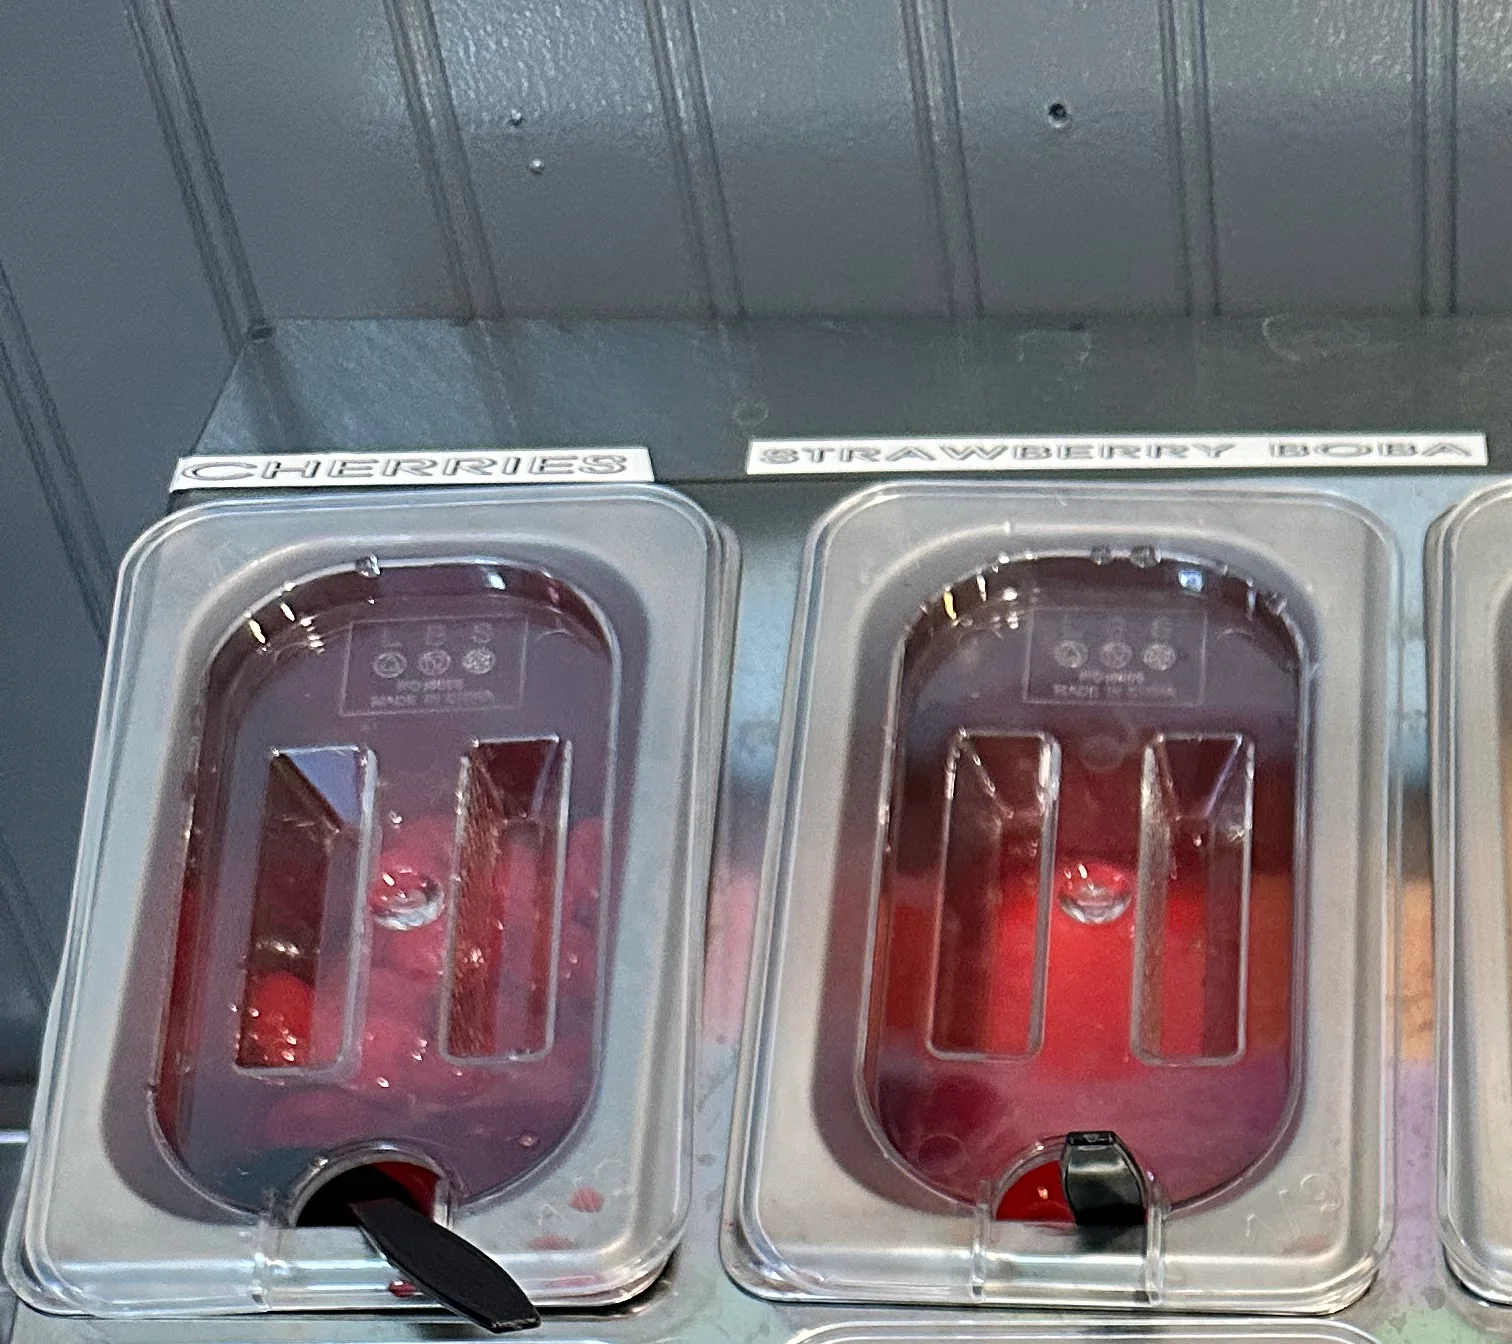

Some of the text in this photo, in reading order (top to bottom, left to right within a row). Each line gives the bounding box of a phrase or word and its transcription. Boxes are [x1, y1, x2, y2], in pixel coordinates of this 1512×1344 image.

[758, 439, 1474, 465] STRAWBERRY BOBA
[181, 454, 628, 481] CHERRIES
